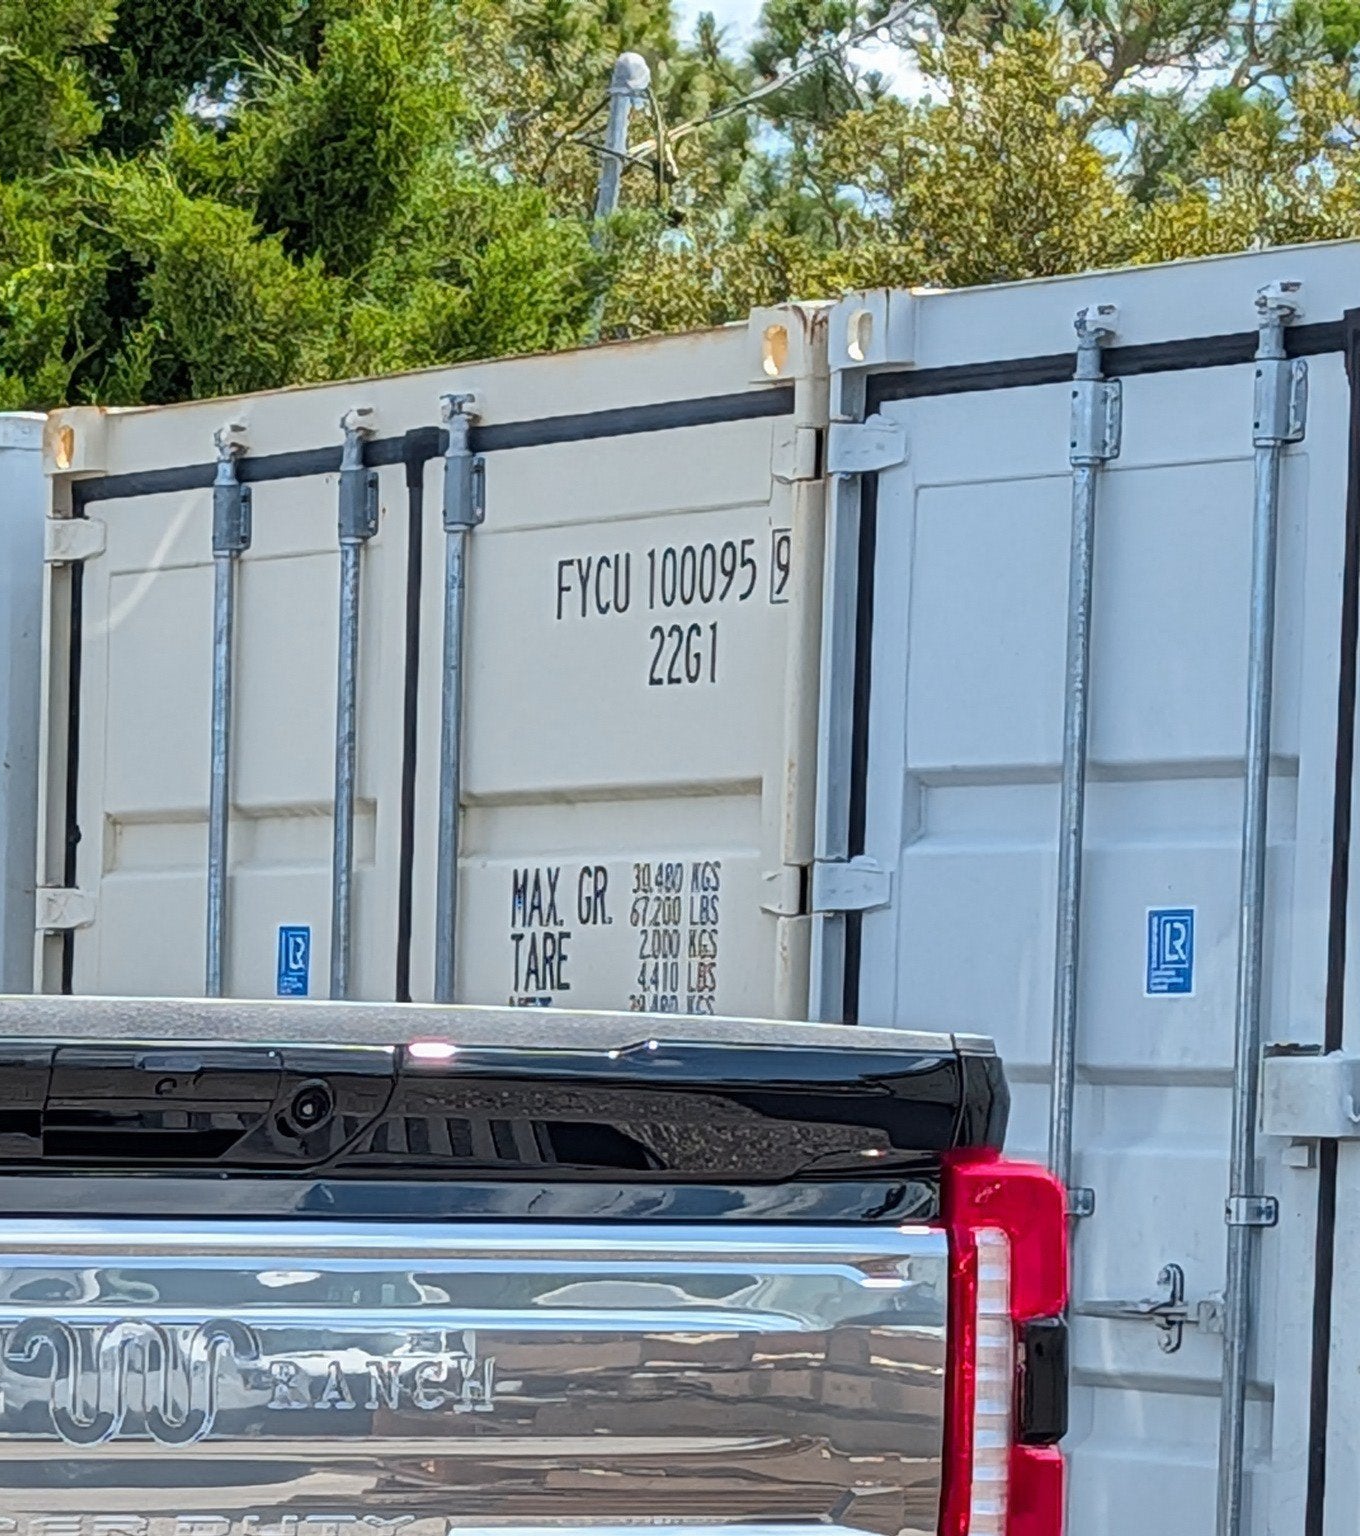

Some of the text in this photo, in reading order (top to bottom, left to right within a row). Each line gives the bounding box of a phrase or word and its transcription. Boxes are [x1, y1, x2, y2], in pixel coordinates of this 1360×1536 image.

[556, 534, 792, 620] FYCU 100095 9
[648, 621, 718, 686] 22G1
[511, 866, 564, 928] MAX.
[577, 865, 614, 925] GR.
[690, 860, 722, 892] KGS
[689, 894, 720, 926] LBS
[510, 931, 572, 992] TARE
[688, 928, 718, 960] KGS
[686, 961, 717, 993] LBS
[267, 1357, 496, 1413] RANCH
